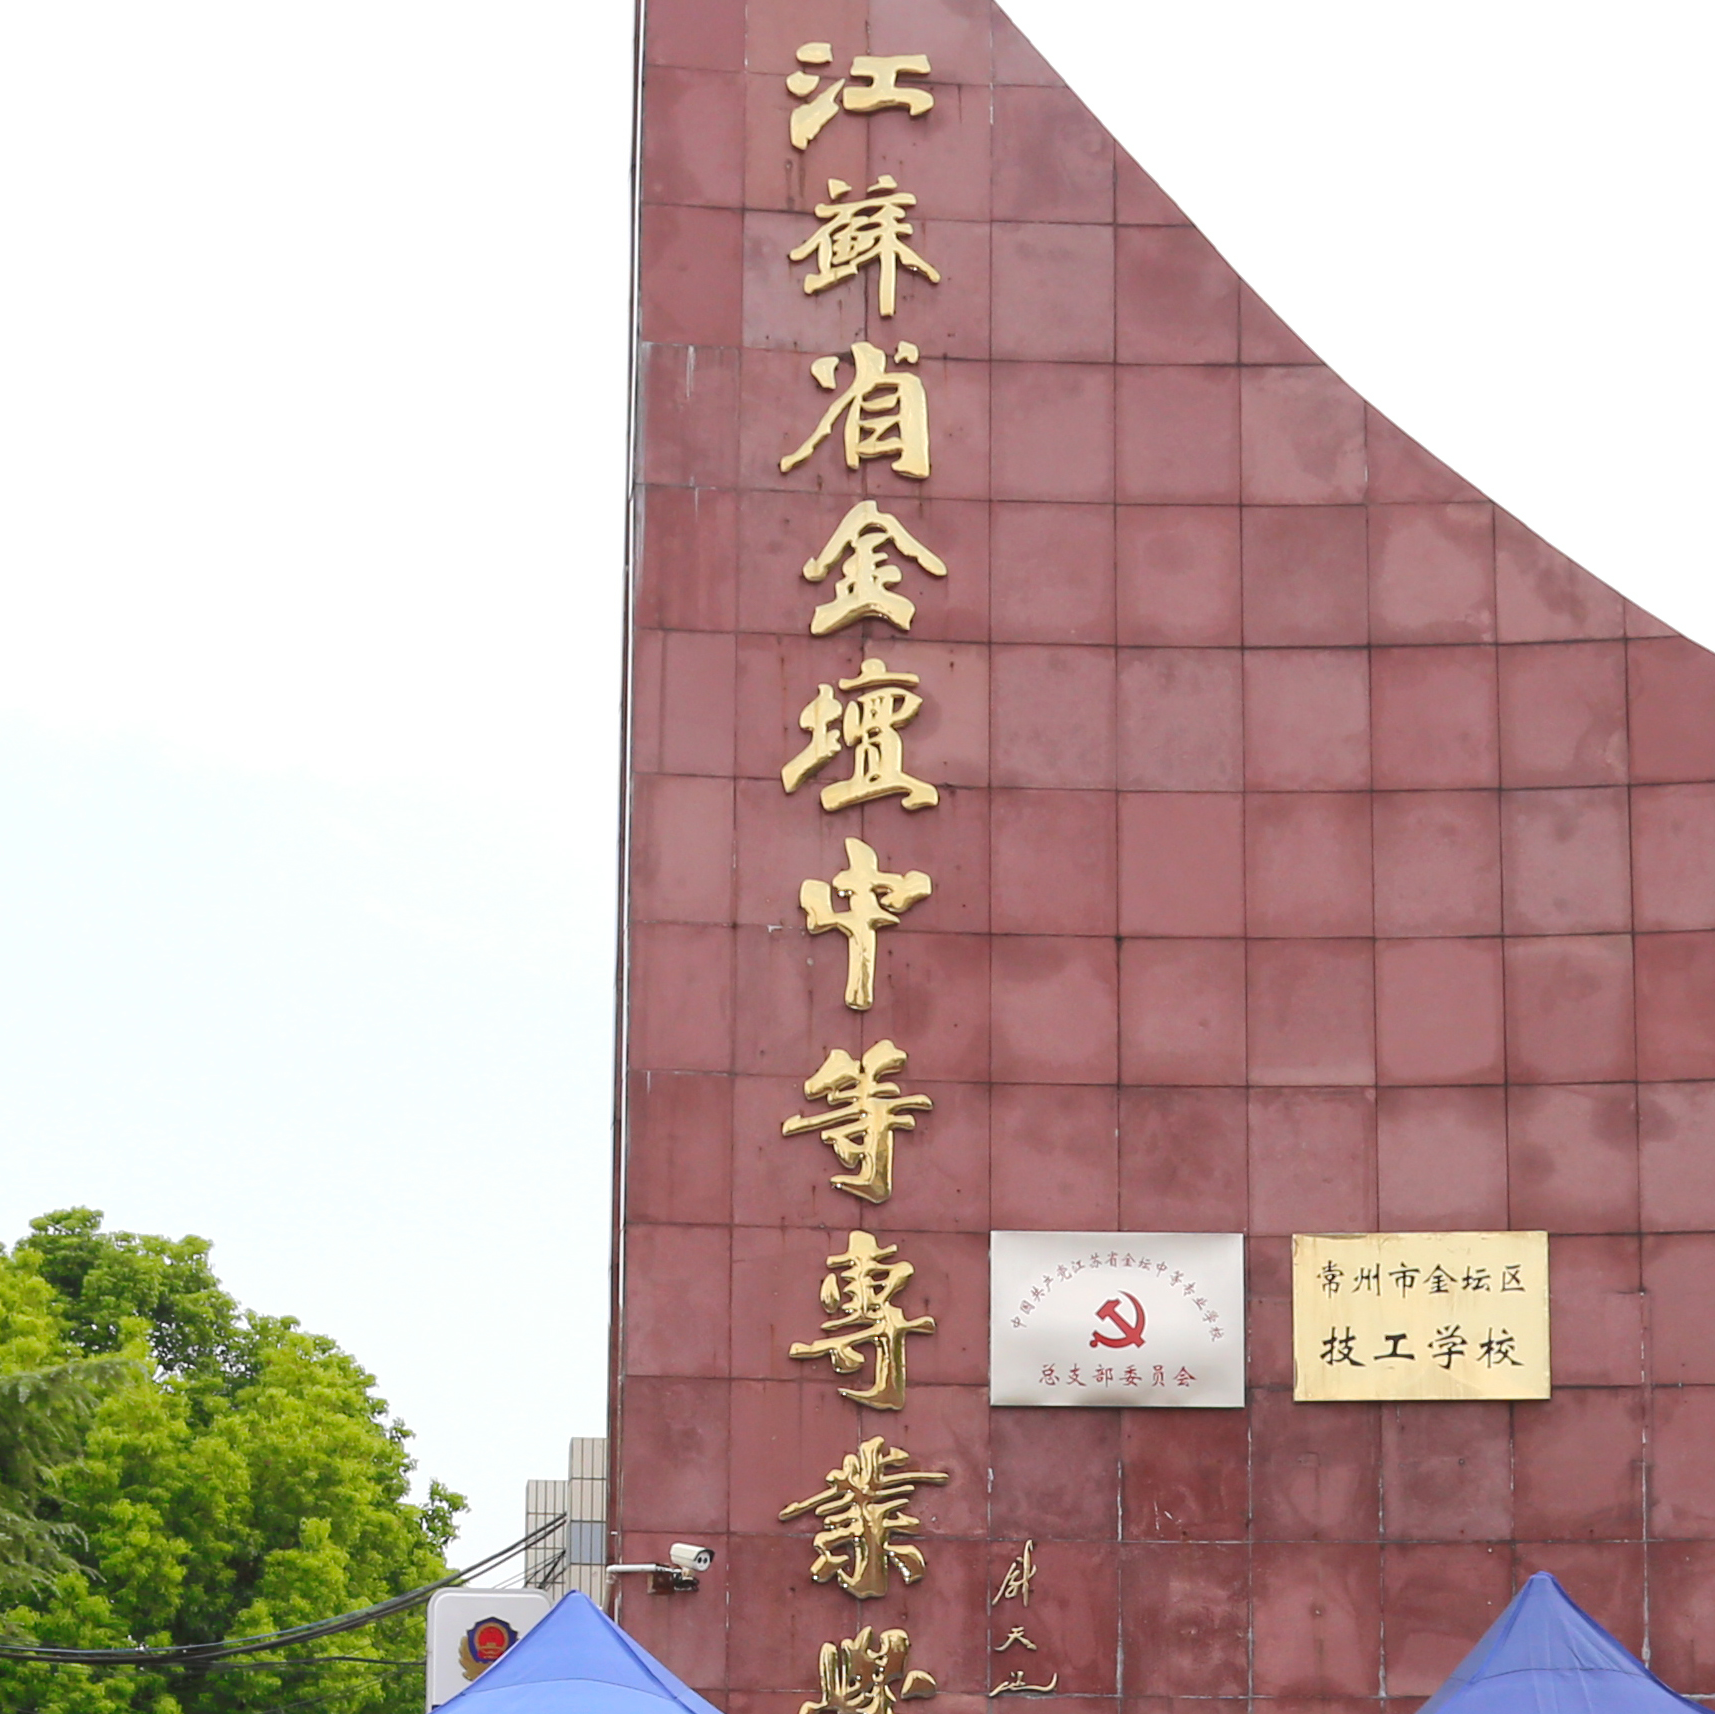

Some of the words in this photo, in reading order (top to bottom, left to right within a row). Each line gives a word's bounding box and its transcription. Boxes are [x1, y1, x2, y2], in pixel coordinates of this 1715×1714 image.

[1316, 1261, 1526, 1299] 常州市金坛区
[1320, 1324, 1525, 1370] 技工学校
[1039, 1363, 1197, 1388] 总支部委员会
